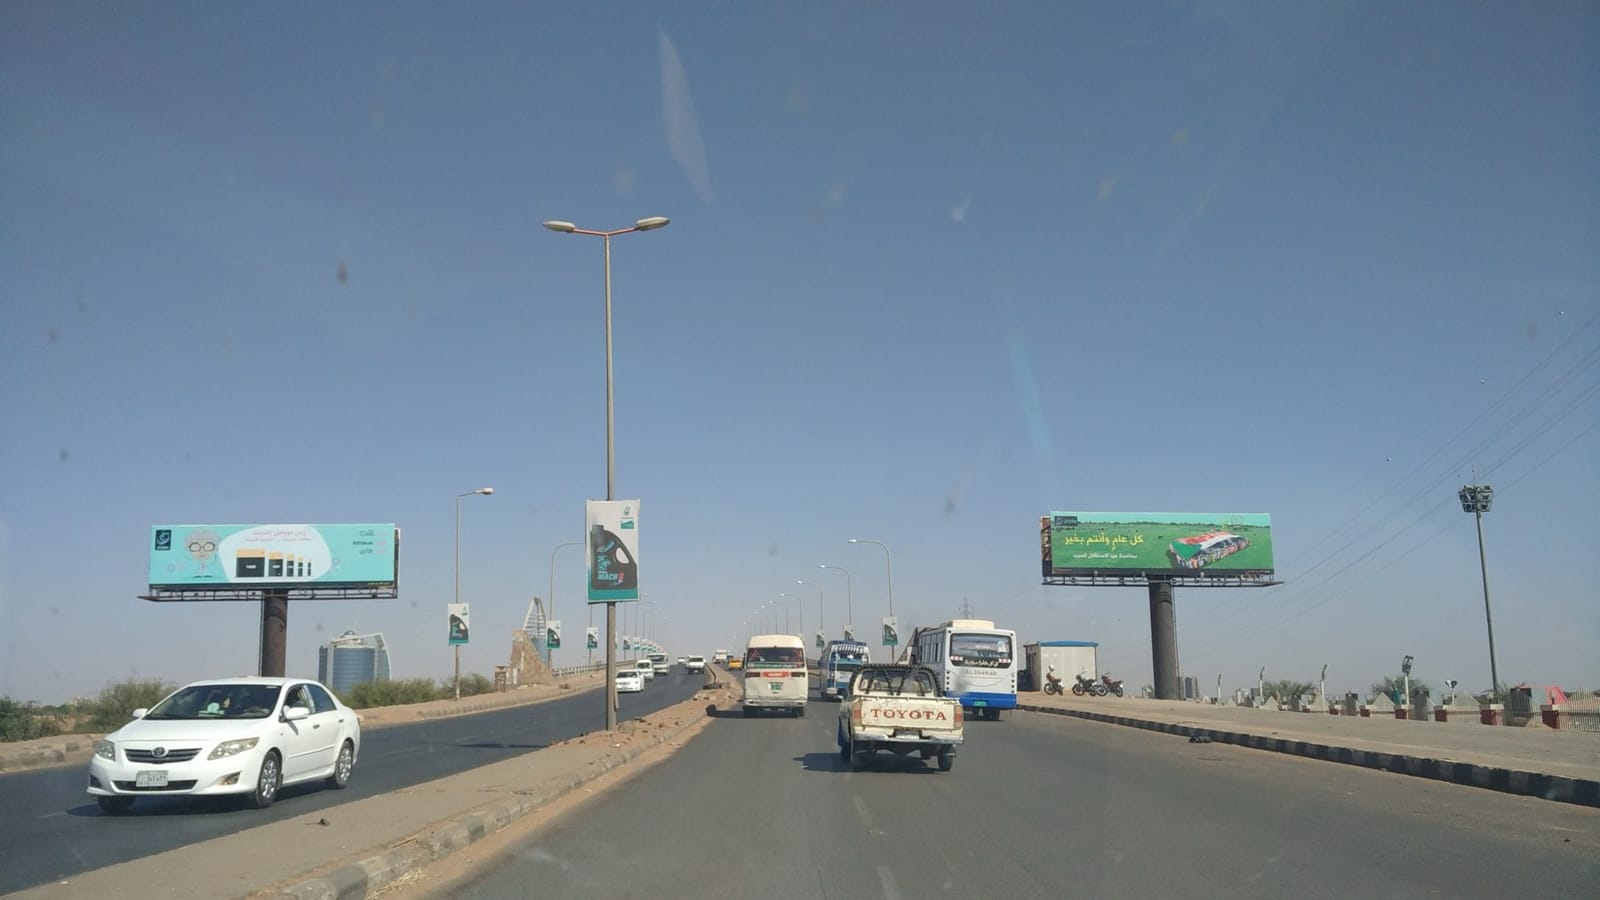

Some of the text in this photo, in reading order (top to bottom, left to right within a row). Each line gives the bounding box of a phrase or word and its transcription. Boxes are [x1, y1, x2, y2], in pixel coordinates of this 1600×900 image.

[1065, 533, 1084, 545] بخير
[1130, 534, 1144, 545] كل
[870, 709, 947, 720] TOYOTA
